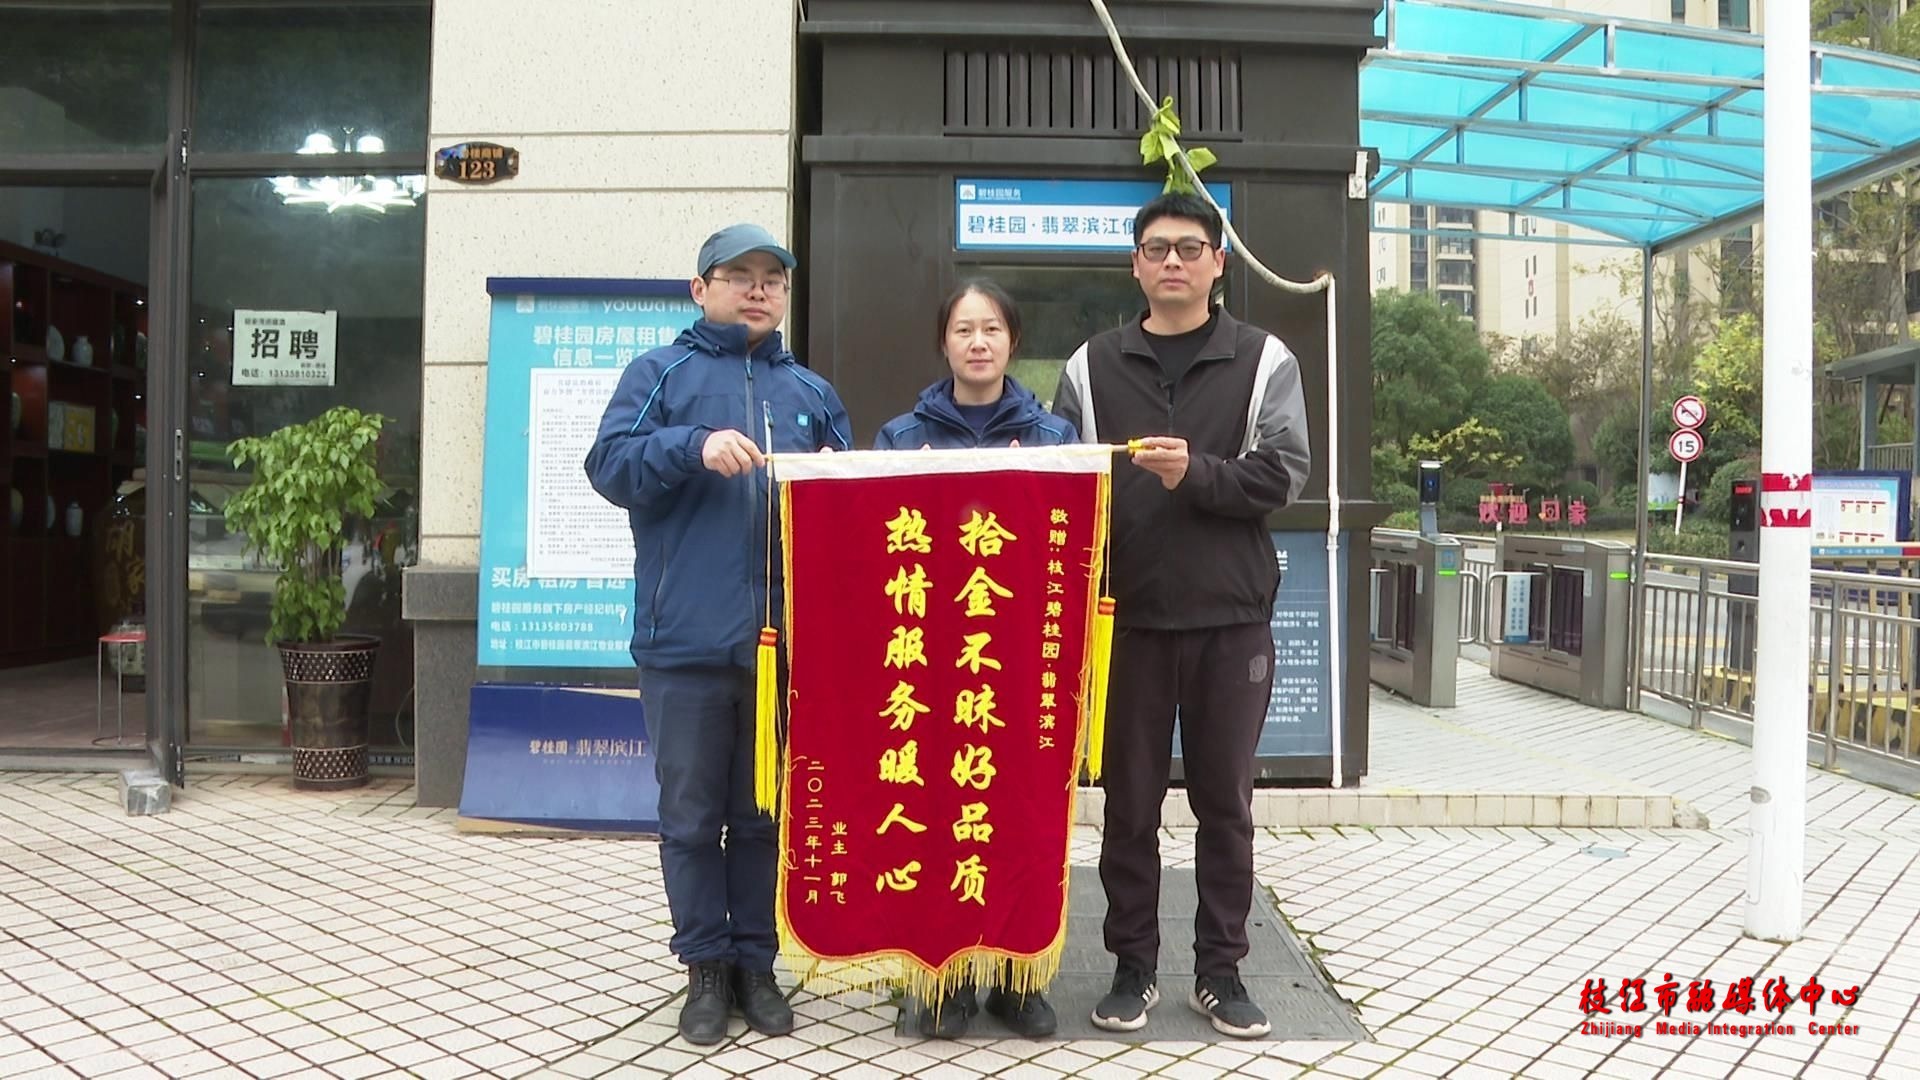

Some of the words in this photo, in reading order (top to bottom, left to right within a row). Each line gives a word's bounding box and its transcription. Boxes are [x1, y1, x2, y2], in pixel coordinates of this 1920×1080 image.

[459, 160, 495, 179] 123
[251, 328, 319, 359] 招聘
[533, 325, 677, 345] 碧桂园房屋租售
[553, 348, 649, 368] 信息一览
[1678, 440, 1695, 453] 15
[1479, 499, 1587, 525] 欢迎回家
[874, 505, 935, 894] 热情服务暖人心
[949, 509, 1018, 907] 拾金不昧好品质
[830, 821, 848, 855] 业主
